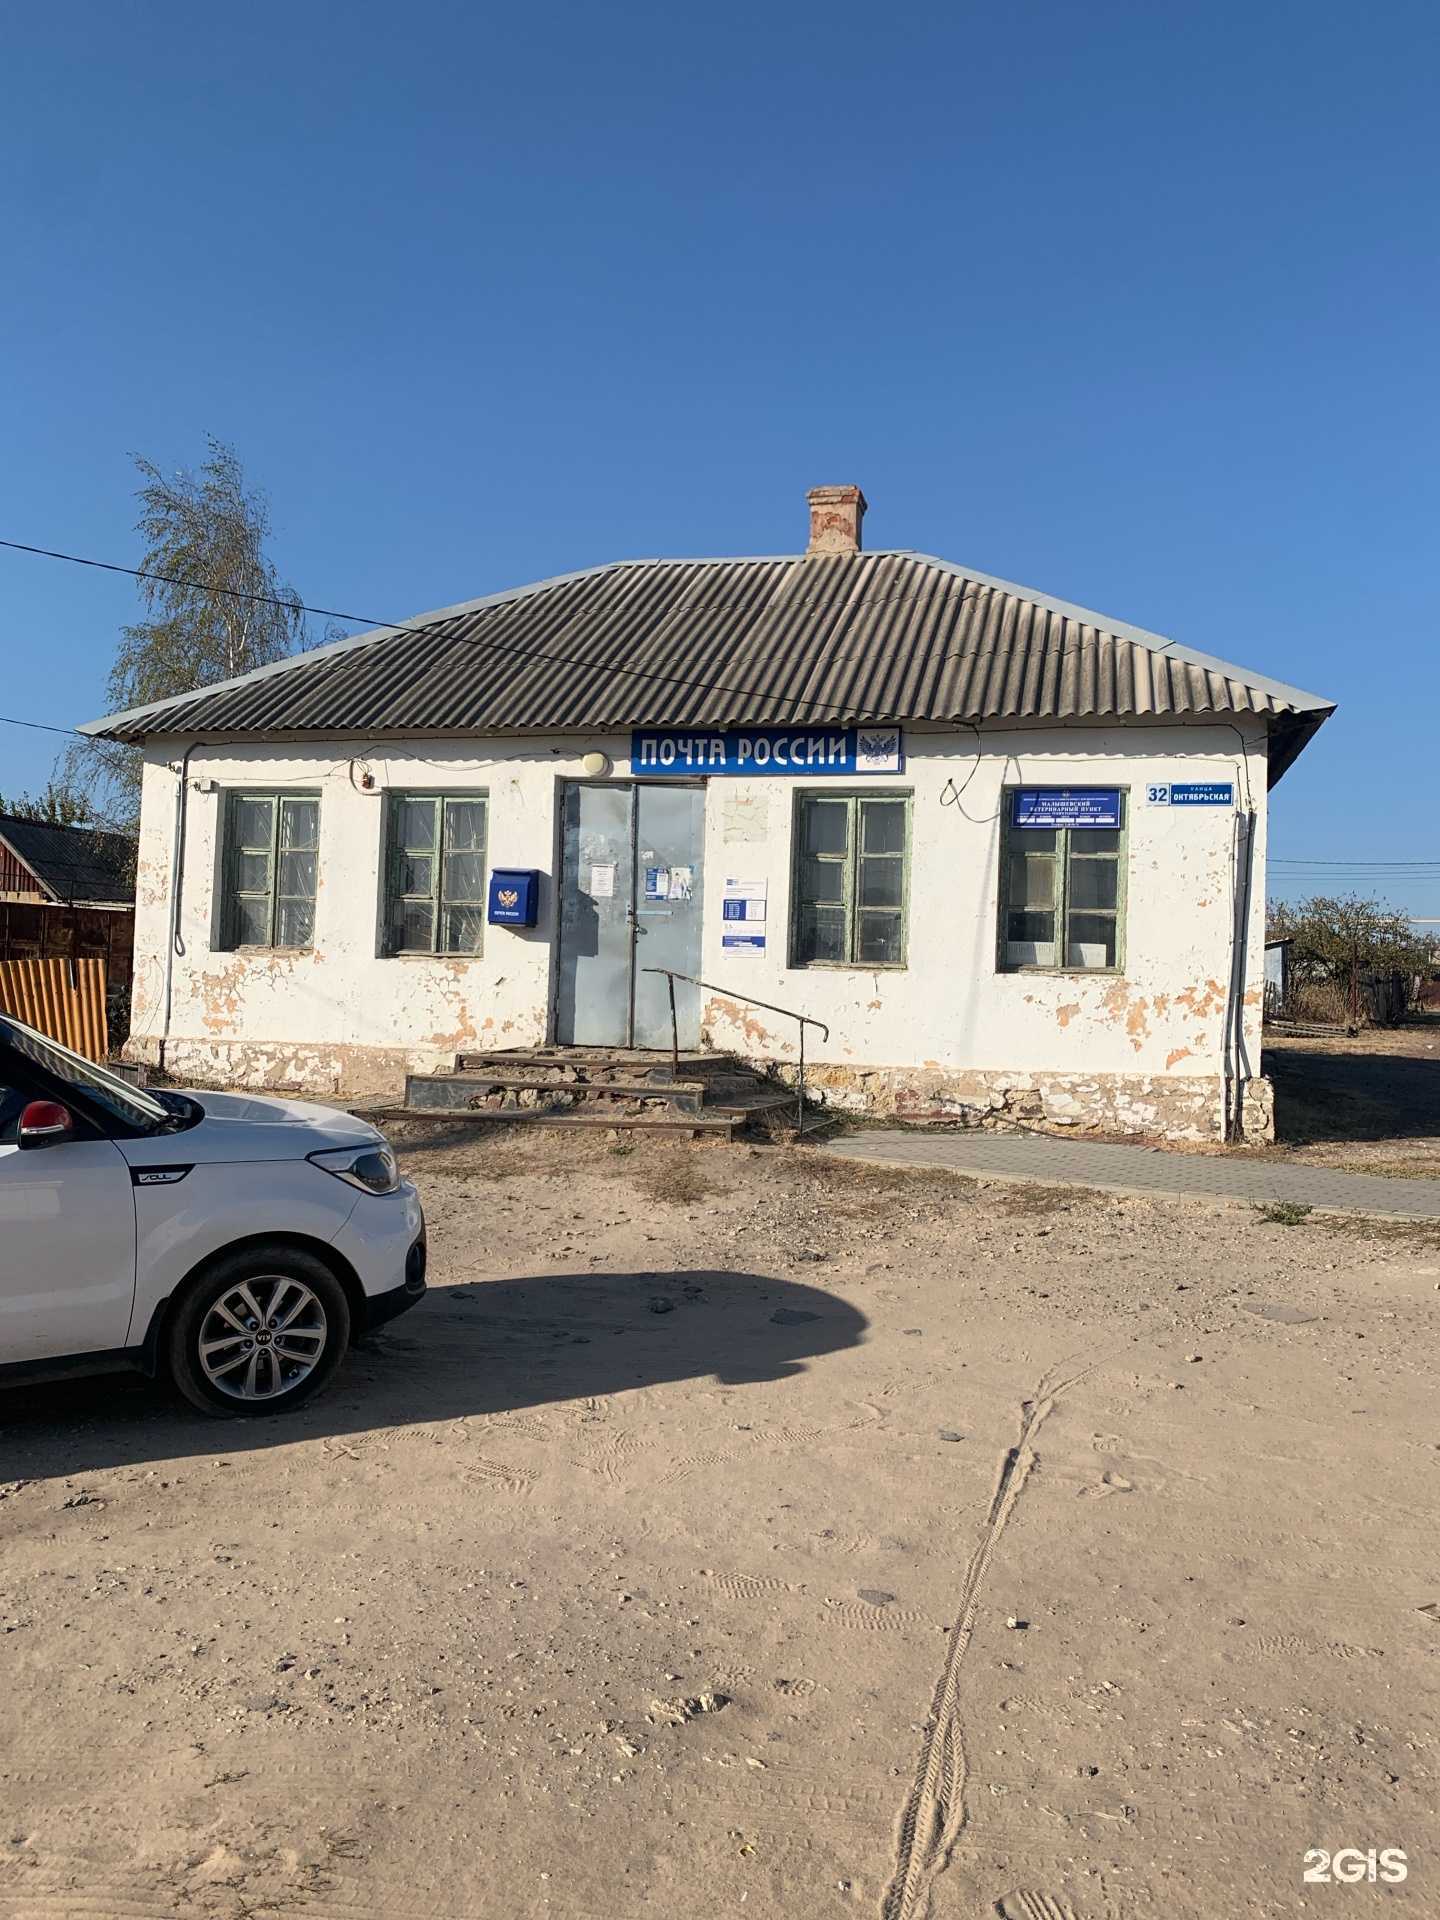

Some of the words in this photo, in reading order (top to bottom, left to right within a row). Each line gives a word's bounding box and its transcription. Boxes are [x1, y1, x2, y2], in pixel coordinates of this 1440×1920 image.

[640, 737, 727, 766] ПОЧТА
[737, 736, 847, 766] РОССИИ
[1148, 787, 1168, 802] 32
[1173, 793, 1230, 801] ОКТЯБРЬСКАЯ
